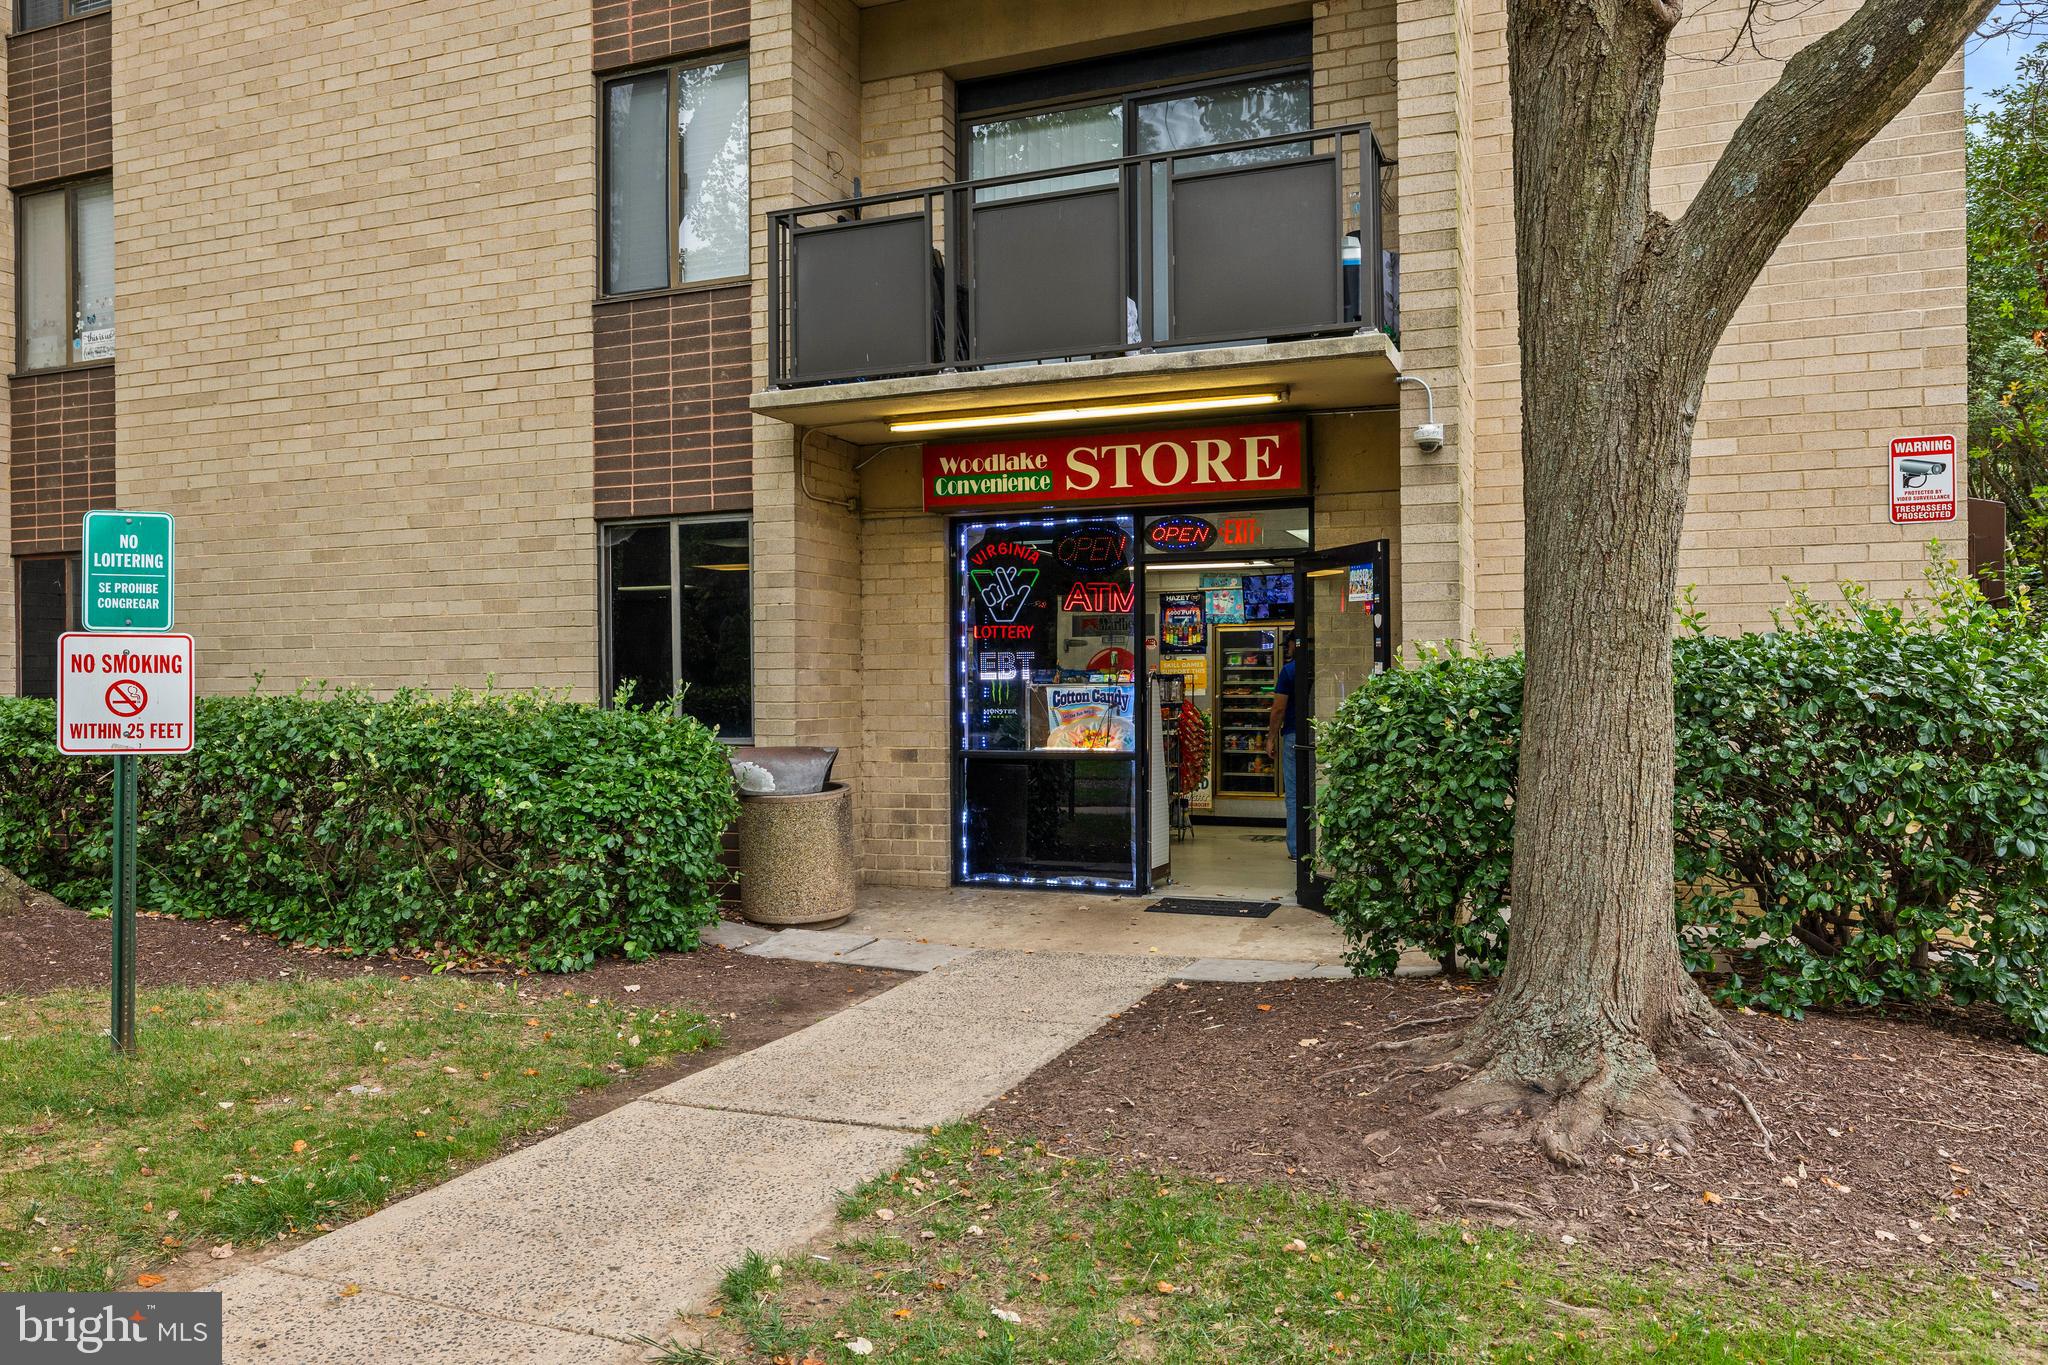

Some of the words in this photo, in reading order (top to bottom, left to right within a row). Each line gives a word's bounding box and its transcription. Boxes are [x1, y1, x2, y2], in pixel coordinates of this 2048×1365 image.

[1894, 440, 1952, 454] WARNING
[939, 452, 1048, 475] Woodlake
[1066, 435, 1283, 491] STORE
[935, 473, 1050, 496] Convenience
[1895, 503, 1953, 513] TRESPASSERS
[1897, 510, 1951, 520] PROSECUTED
[1152, 527, 1209, 542] OPEN
[1224, 519, 1257, 544] EXIT
[119, 534, 138, 549] NO
[1057, 534, 1127, 561] OPEN
[93, 553, 164, 569] LOITERING
[971, 542, 1040, 566] VIRGINIA
[98, 582, 111, 594] SE
[114, 582, 159, 595] PROHIBE
[97, 597, 160, 610] CONGREGAR
[1063, 582, 1135, 612] ATM
[973, 625, 1034, 640] LOTTERY
[71, 654, 95, 674] NO
[102, 654, 182, 674] SMOKING
[979, 652, 1035, 680] EBT
[1053, 690, 1090, 707] Cotton
[1092, 687, 1129, 711] Candy
[983, 708, 1018, 716] MONSTER
[70, 723, 122, 739] WITHIN
[127, 723, 145, 739] 25
[150, 723, 183, 739] FEET
